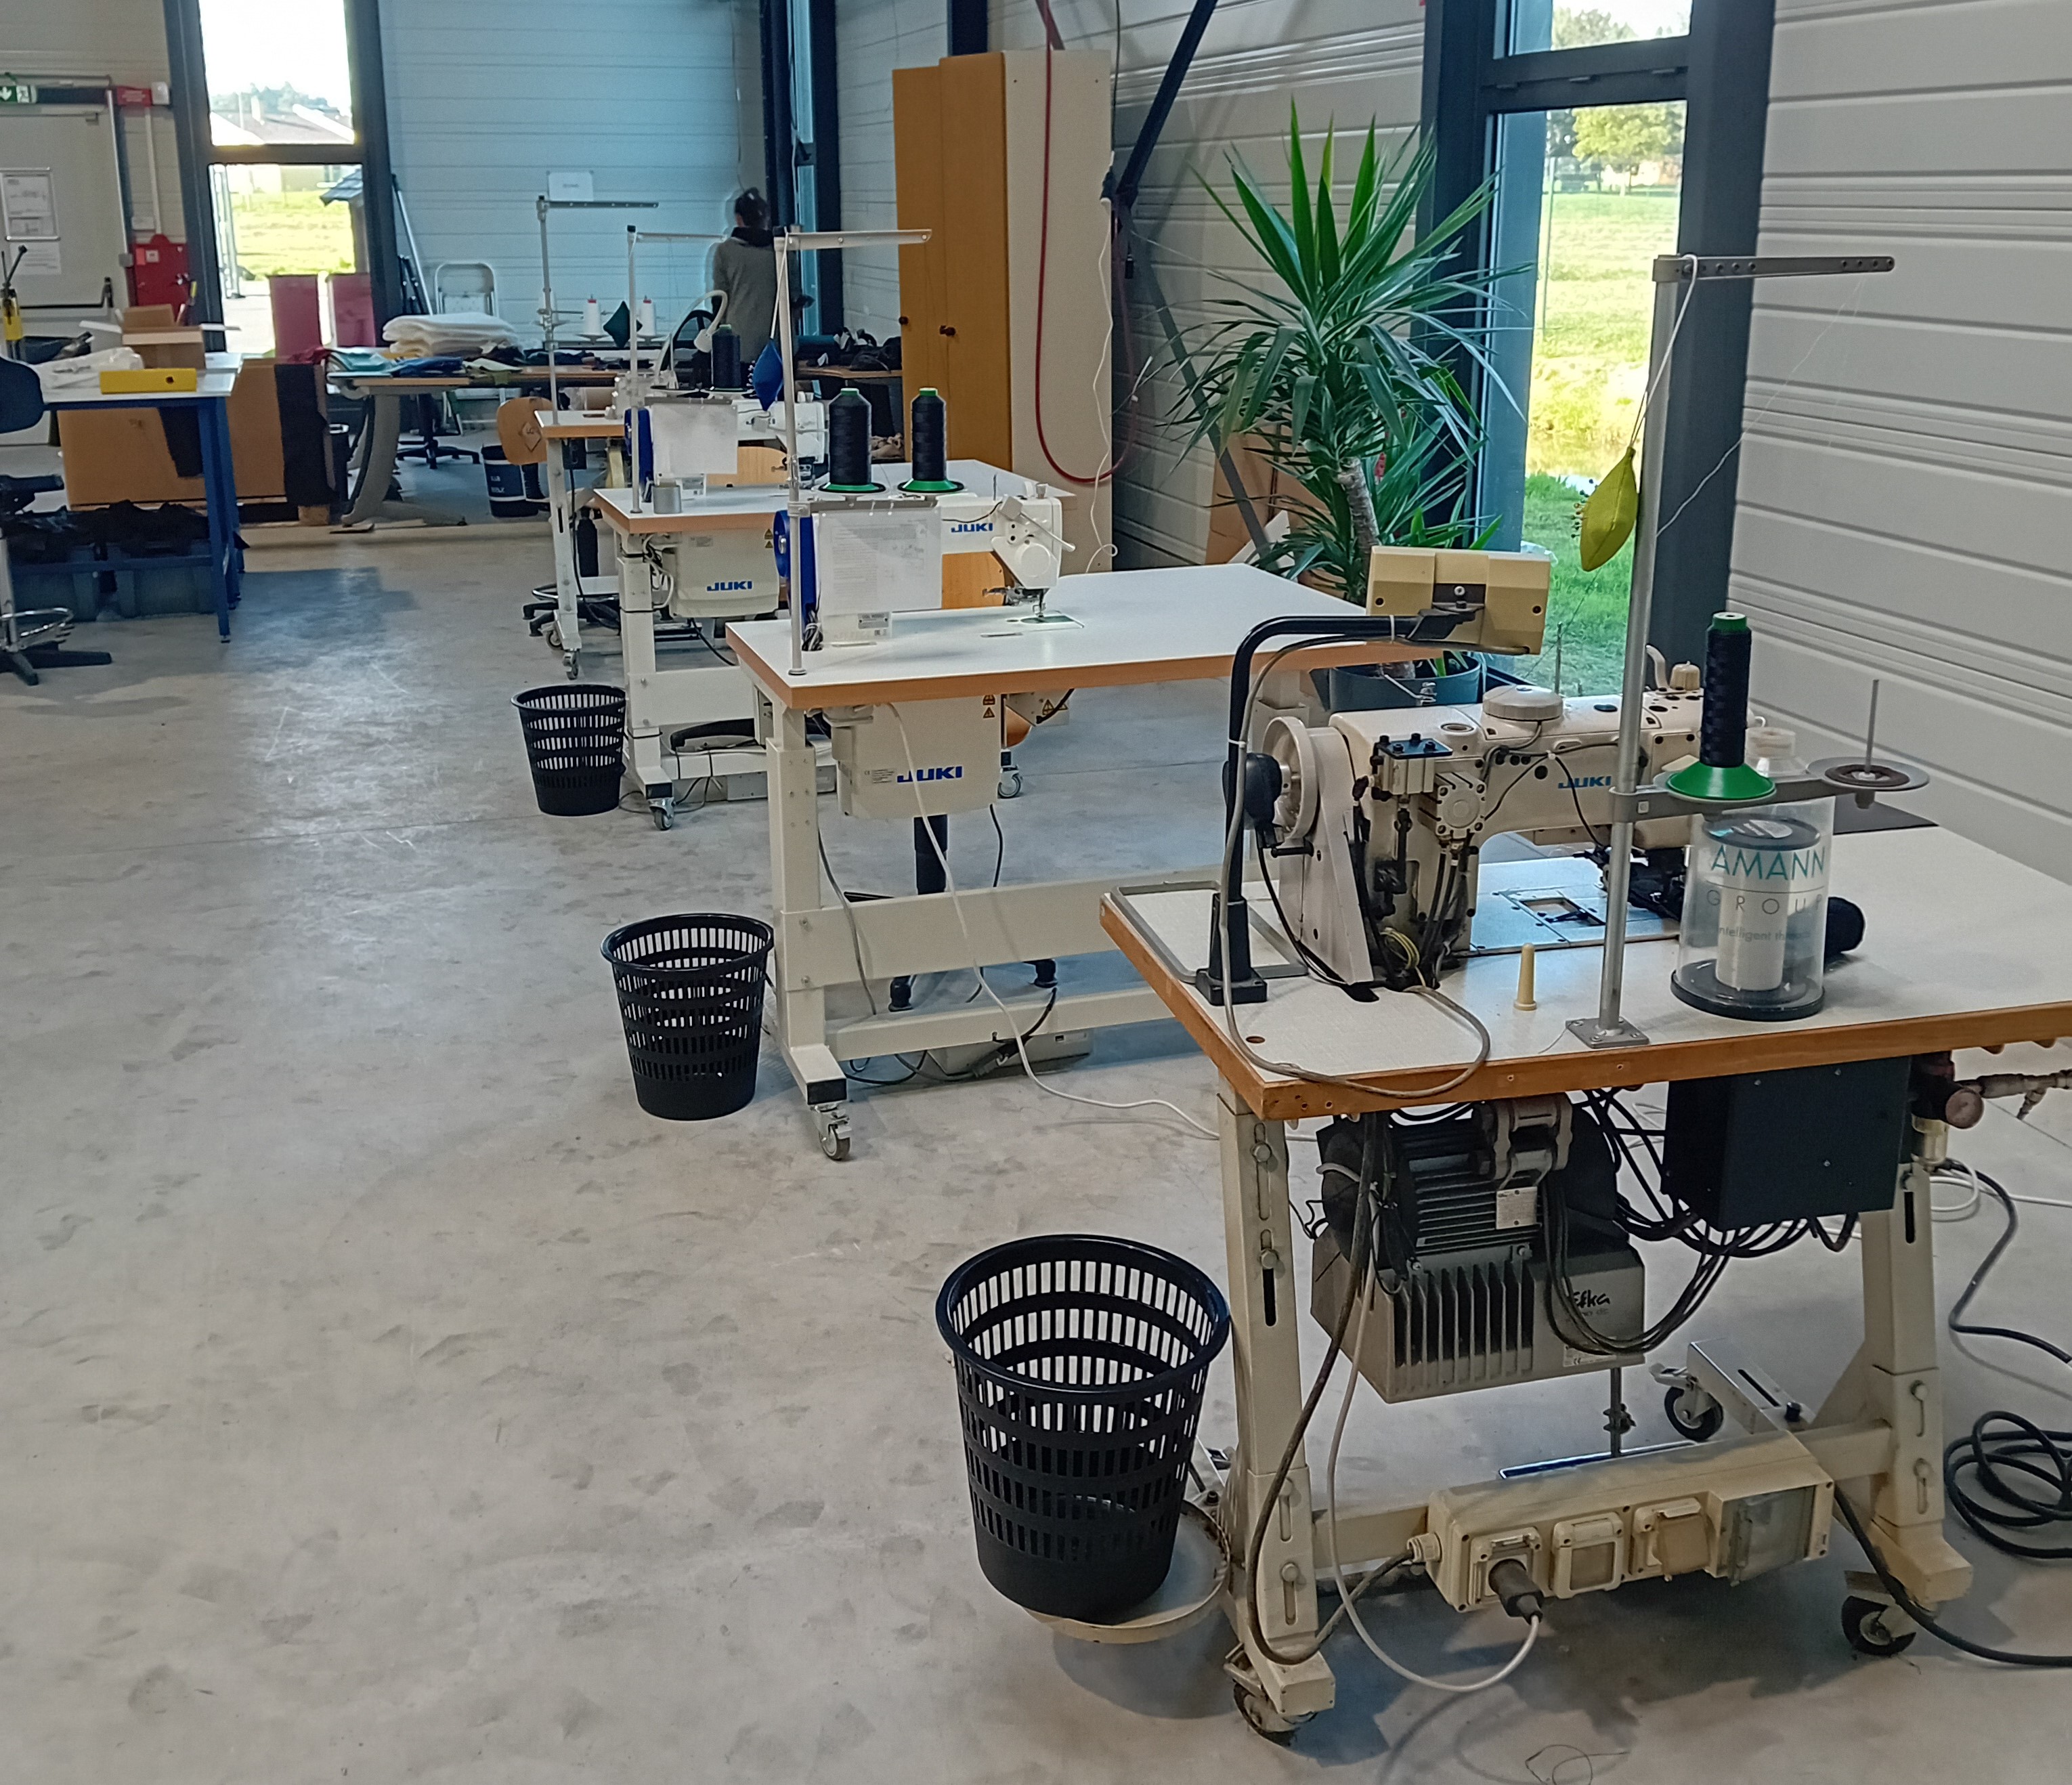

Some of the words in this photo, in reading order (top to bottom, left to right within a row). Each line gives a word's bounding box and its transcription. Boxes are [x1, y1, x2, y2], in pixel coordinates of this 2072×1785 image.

[950, 522, 993, 533] JUKI
[706, 580, 752, 591] JUKI
[897, 766, 963, 783] JUKI
[1557, 775, 1612, 789] JUKI
[1710, 844, 1826, 881] AMANN
[1706, 889, 1823, 914] GROUP
[1717, 925, 1772, 942] ntelligent
